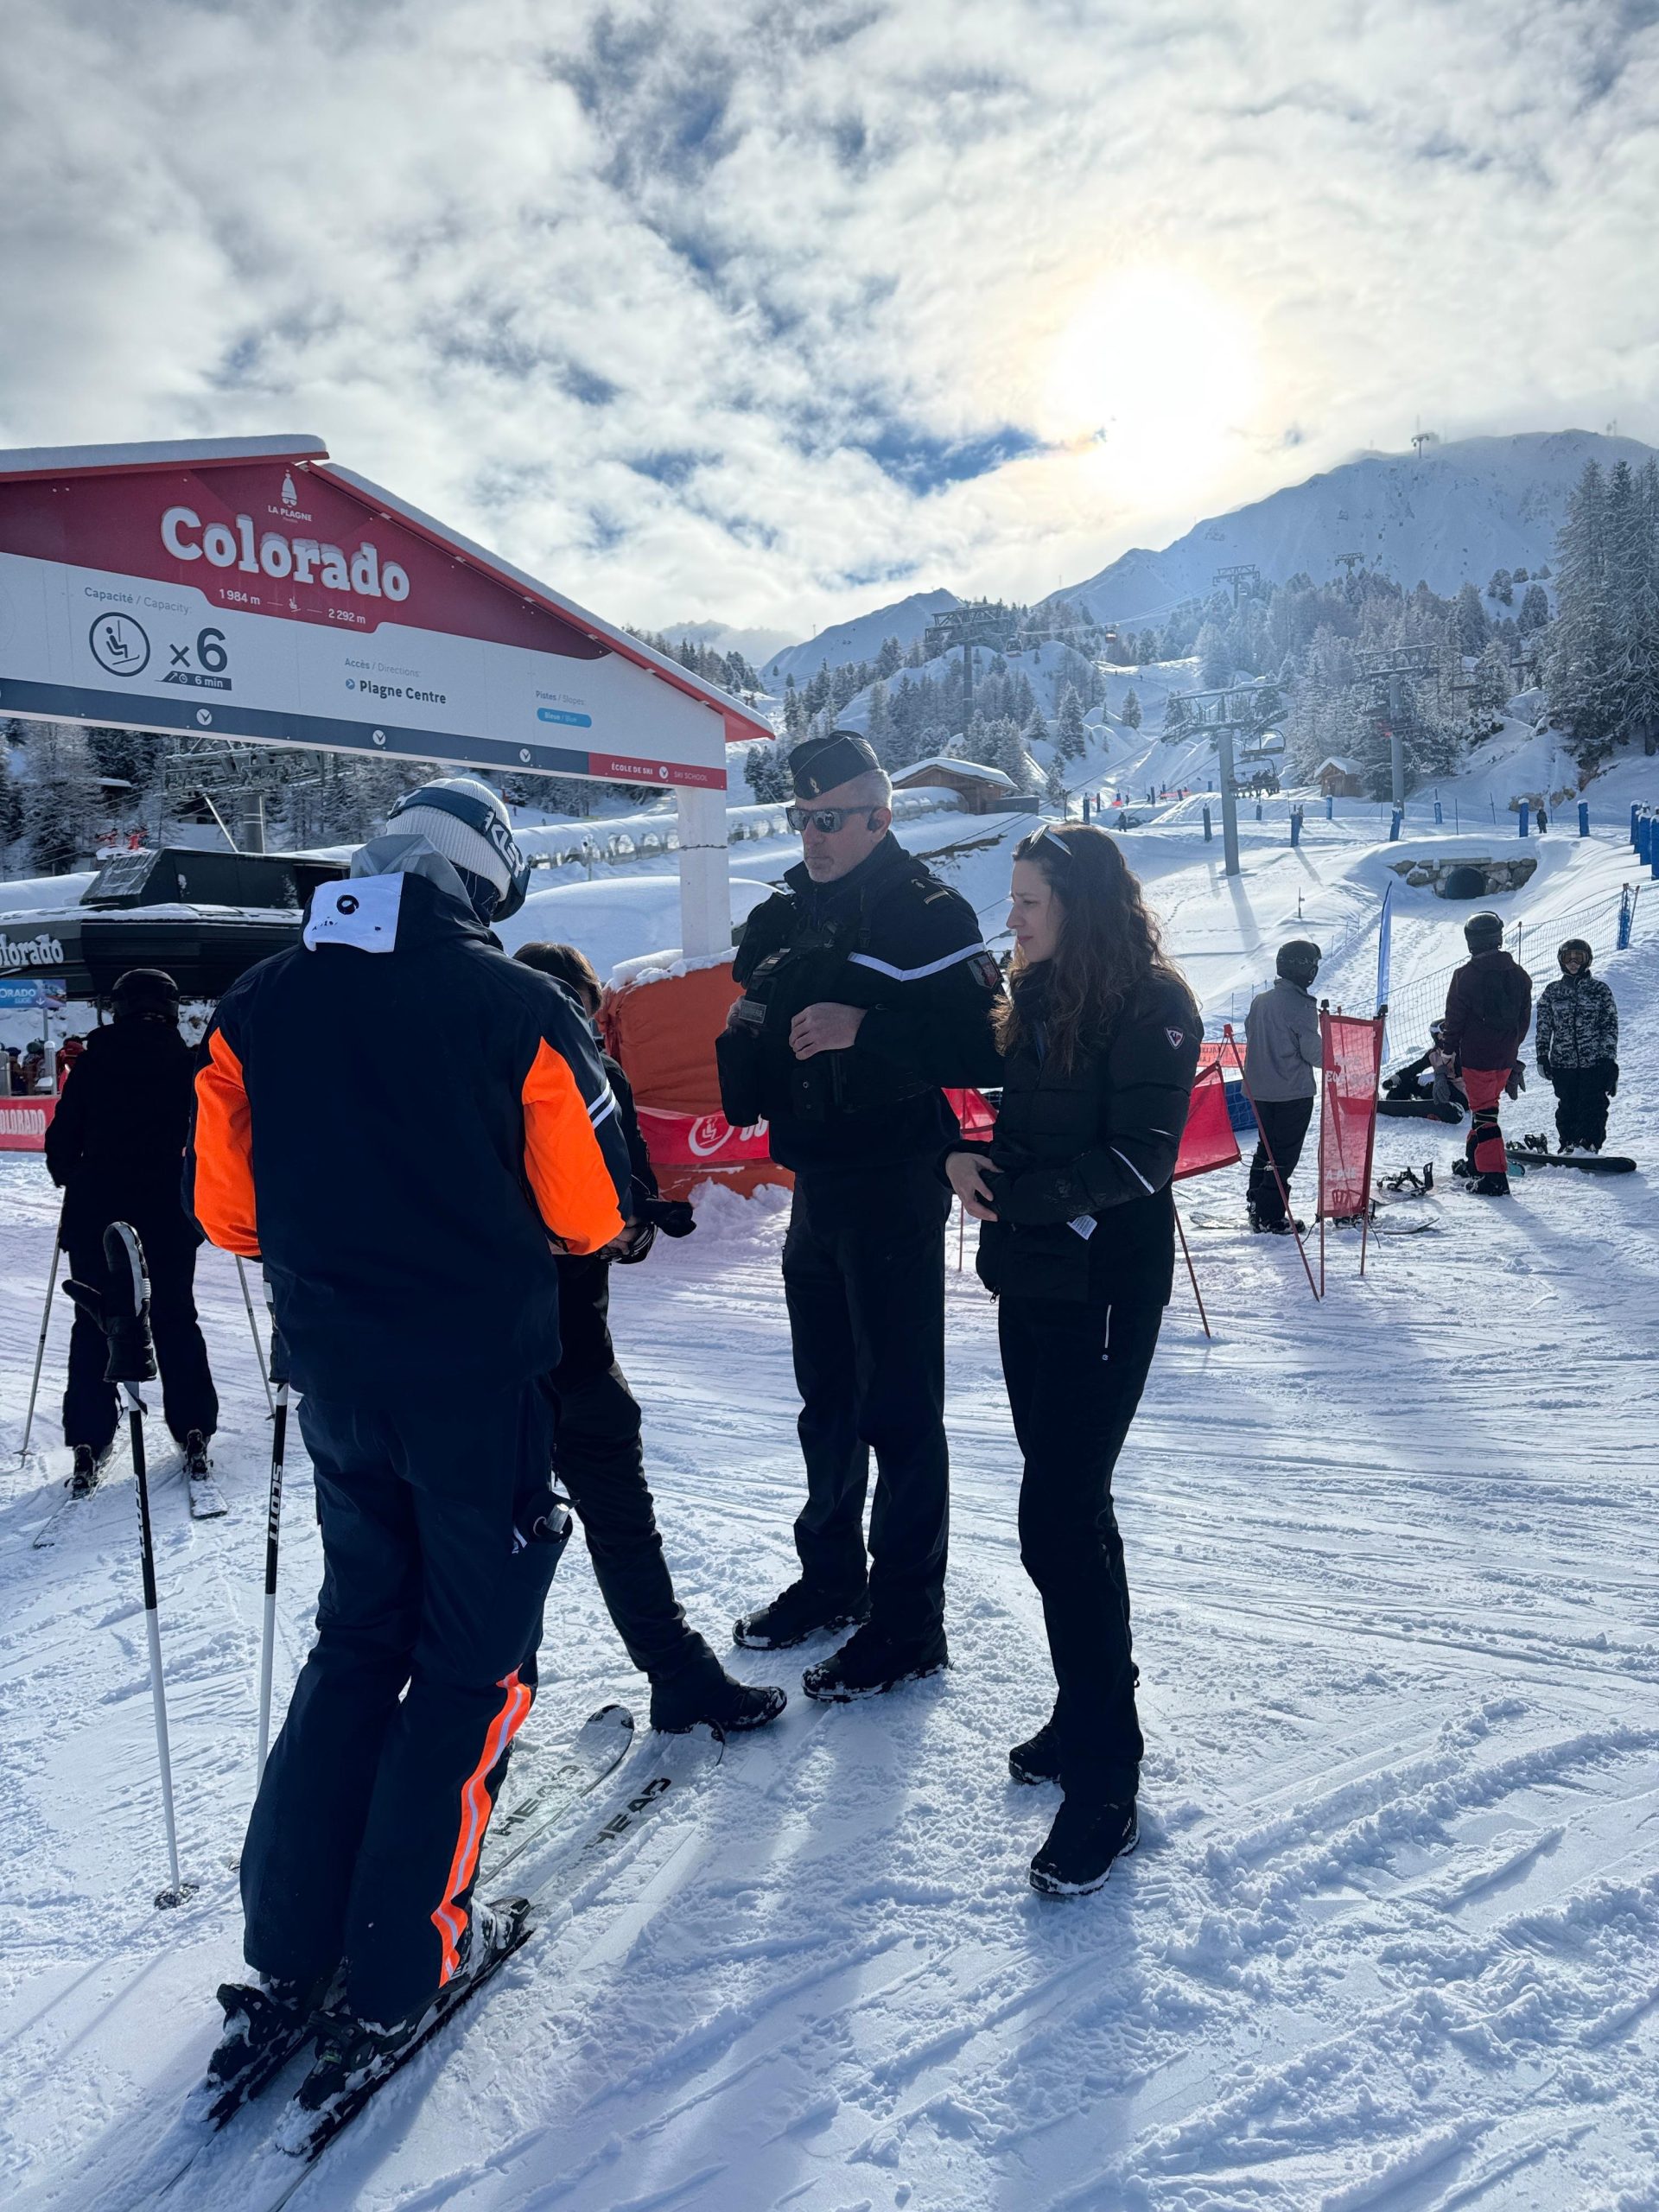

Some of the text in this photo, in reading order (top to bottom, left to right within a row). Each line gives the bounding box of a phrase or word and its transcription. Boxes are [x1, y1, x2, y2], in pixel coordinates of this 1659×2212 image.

[268, 505, 279, 514] LA
[280, 508, 312, 522] PLAGNE
[161, 505, 410, 602] Colorado
[85, 587, 133, 604] Capacité
[143, 596, 193, 615] Capacity:
[251, 594, 260, 605] m
[357, 614, 366, 625] m
[344, 658, 371, 670] Accès
[194, 675, 223, 689] 6 min
[359, 680, 447, 704] Plagne Centre
[536, 690, 557, 702] Pistes
[611, 762, 653, 775] ÉCOLE DE SKI
[683, 772, 708, 782] SCHOOL
[0, 933, 64, 966] lorado
[269, 1461, 283, 1548] SCOTT
